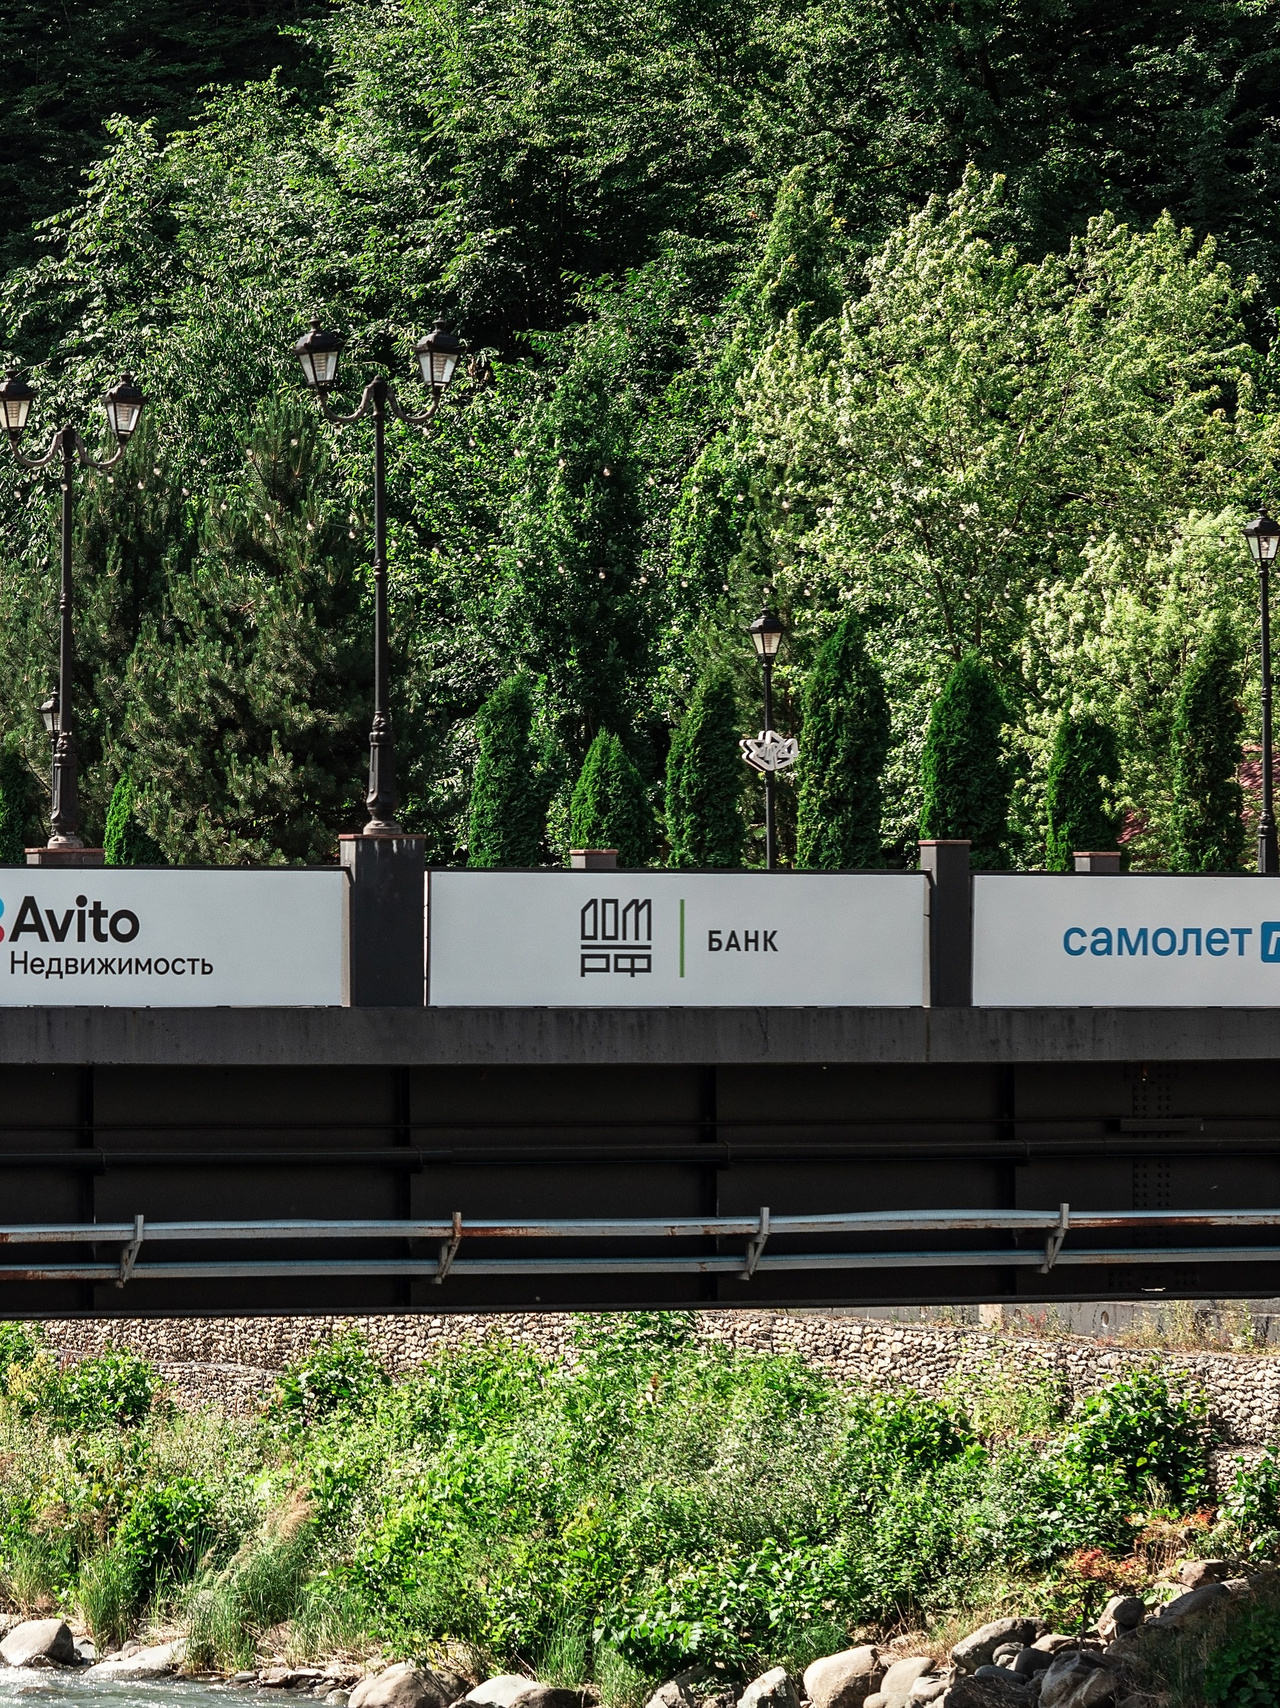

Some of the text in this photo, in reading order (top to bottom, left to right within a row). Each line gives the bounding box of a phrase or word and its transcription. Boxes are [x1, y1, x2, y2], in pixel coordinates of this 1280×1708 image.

[8, 894, 141, 943] Avito
[707, 929, 779, 952] БАНК
[1062, 926, 1253, 957] самолет
[10, 950, 214, 980] Недвижимость
